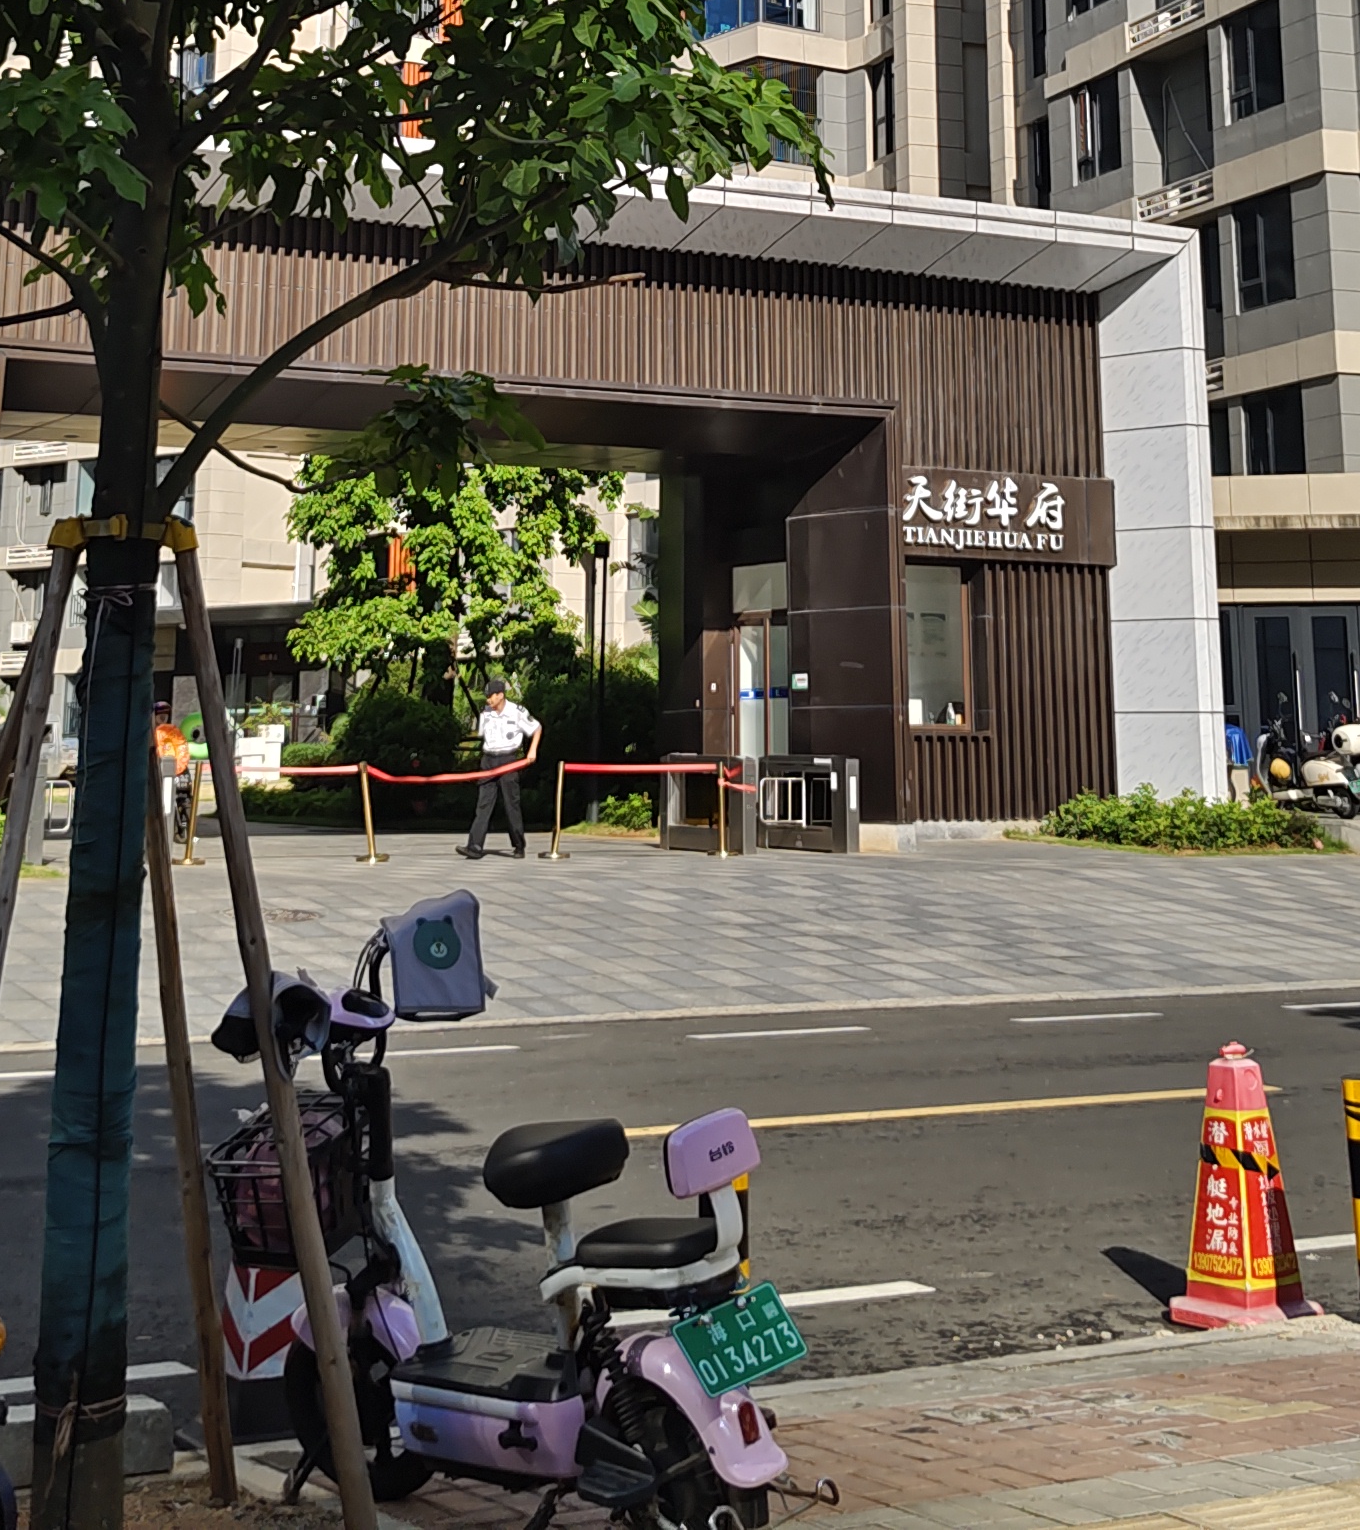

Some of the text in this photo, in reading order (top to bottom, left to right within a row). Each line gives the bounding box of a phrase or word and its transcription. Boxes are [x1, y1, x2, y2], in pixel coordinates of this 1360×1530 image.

[903, 475, 1066, 530] 天街华府
[1205, 1120, 1230, 1255] 潜艇地漏
[698, 1320, 799, 1385] 0134273
[707, 1309, 756, 1346] 海口
